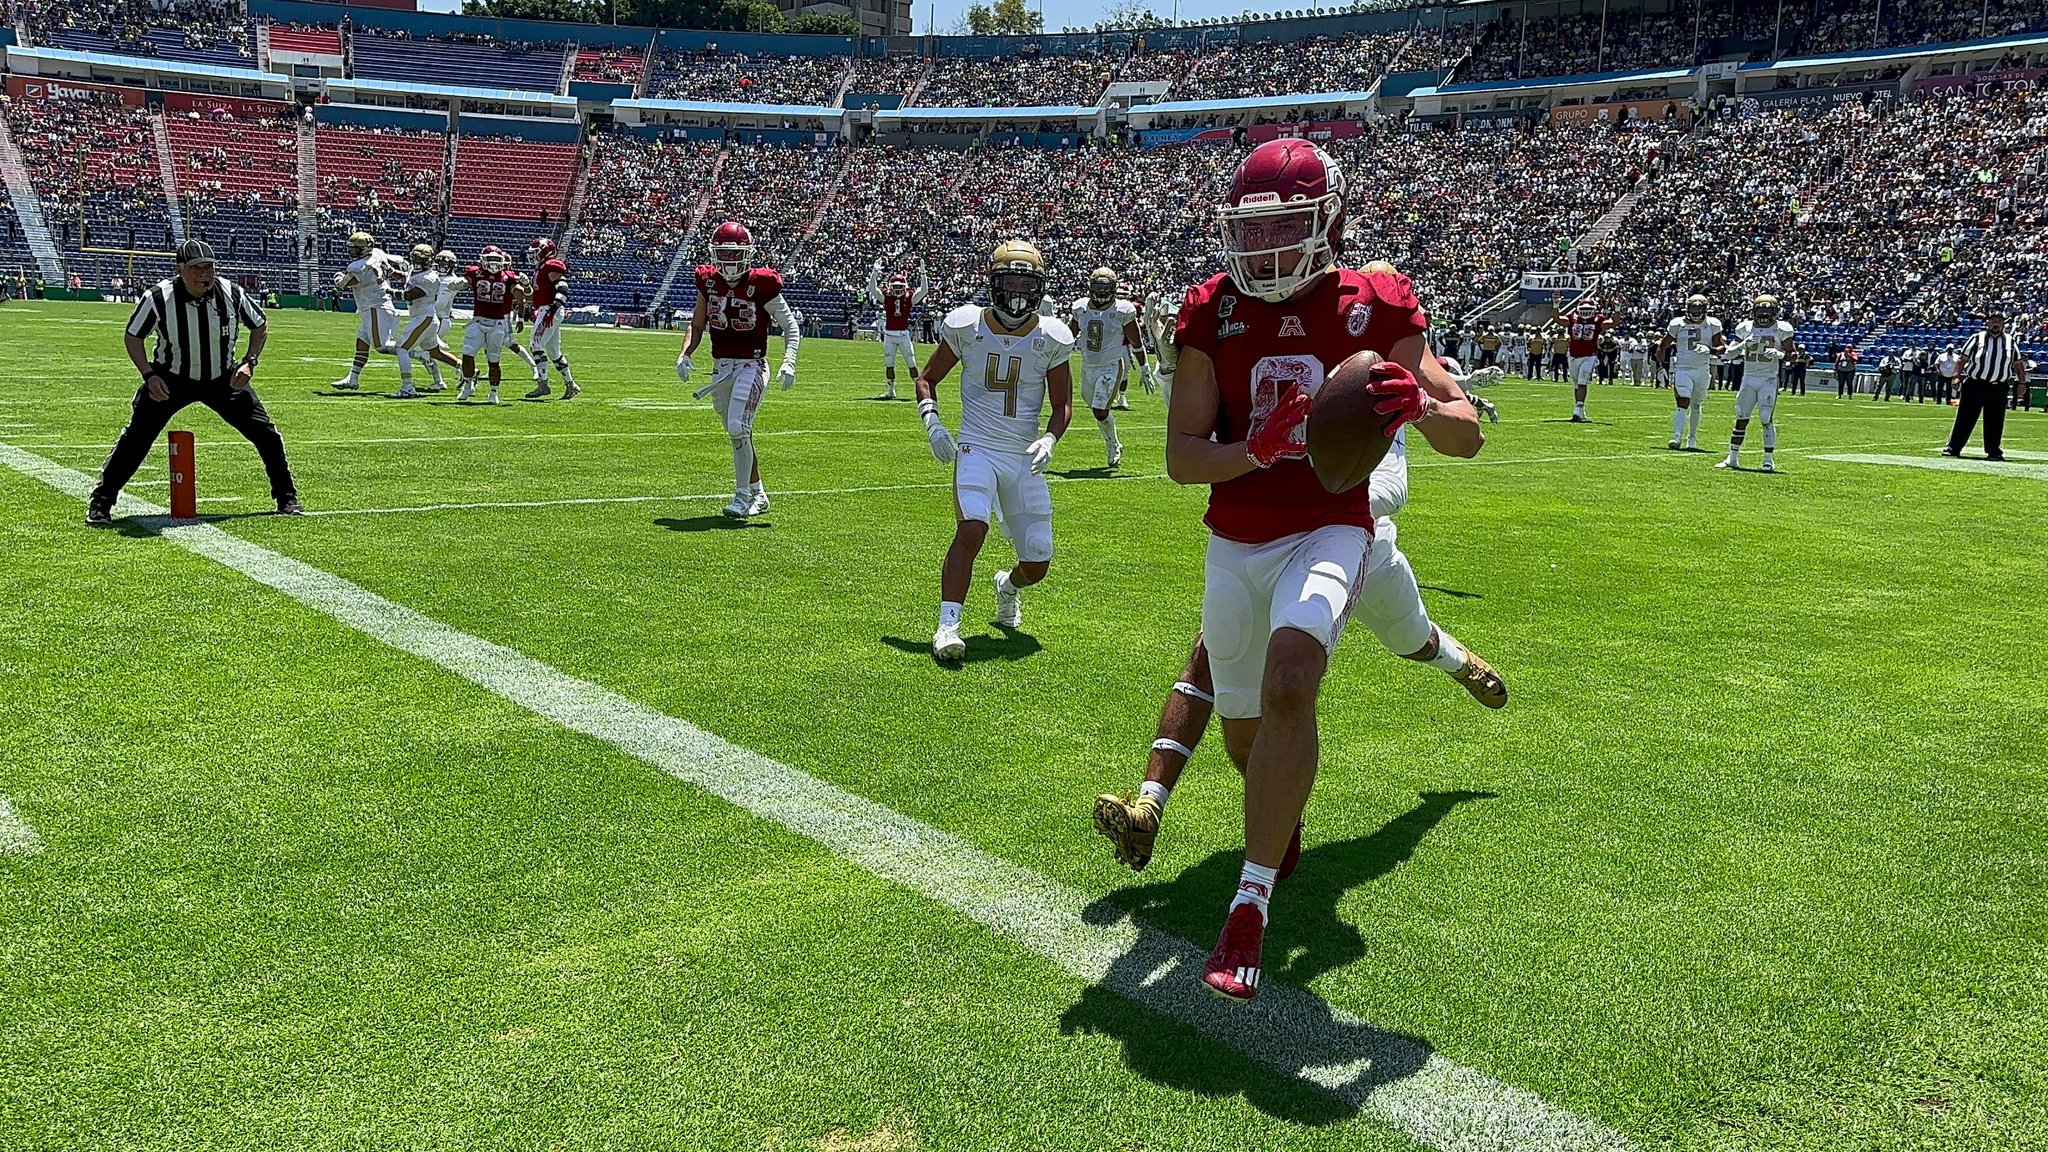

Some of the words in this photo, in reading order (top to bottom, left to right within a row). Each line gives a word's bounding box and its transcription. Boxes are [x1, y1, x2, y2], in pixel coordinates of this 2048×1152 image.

[1800, 95, 1827, 104] PLAZA
[1833, 91, 1863, 101] NUEVO
[1872, 90, 1893, 98] OTEL
[257, 105, 278, 113] SUIZ
[1555, 109, 1588, 120] GRUPO
[1243, 193, 1275, 204] Riddell
[1537, 275, 1577, 289] YARDA
[476, 280, 506, 303] 22
[707, 295, 757, 331] 83
[221, 325, 230, 336] H
[1086, 319, 1104, 352] 9
[1688, 328, 1702, 351] 2
[985, 352, 1022, 418] 4
